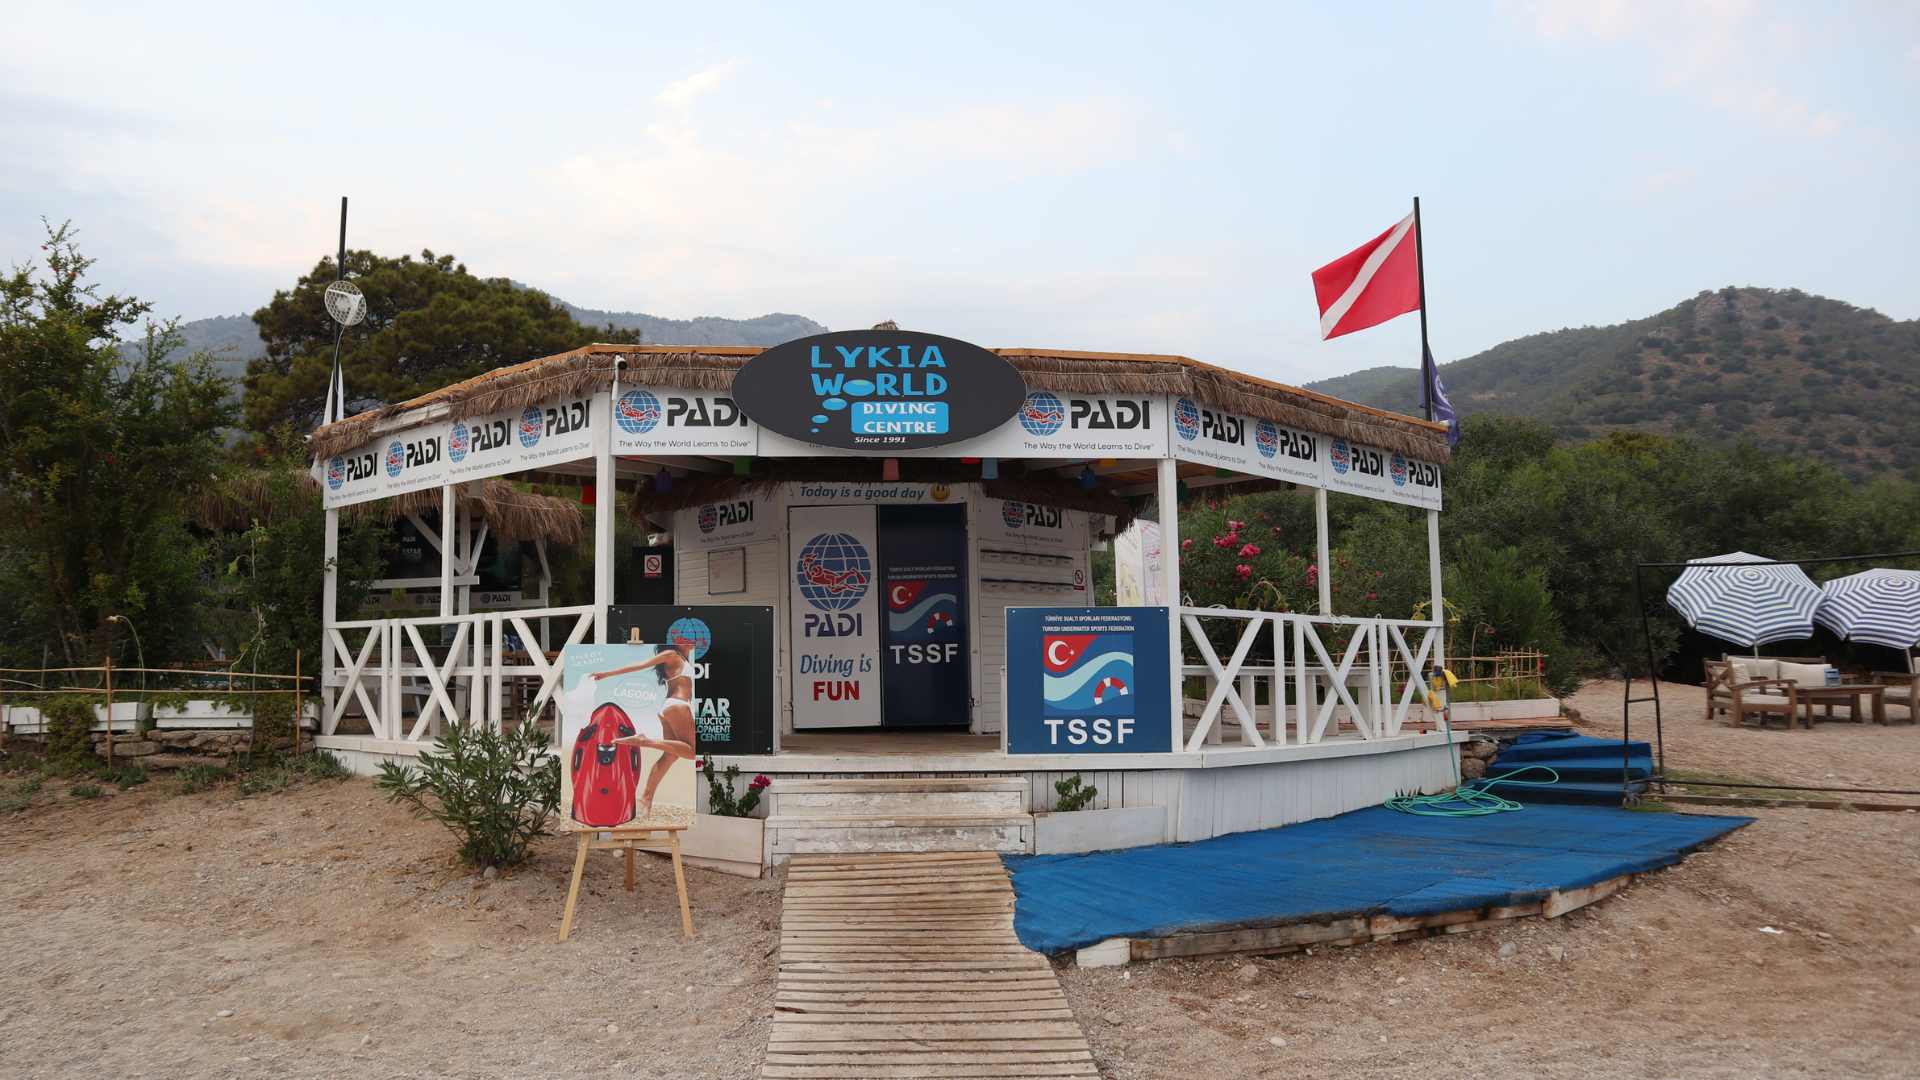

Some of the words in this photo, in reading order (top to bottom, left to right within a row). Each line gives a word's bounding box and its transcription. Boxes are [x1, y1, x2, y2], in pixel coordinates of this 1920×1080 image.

[811, 345, 947, 369] LYKIA
[811, 372, 949, 397] WORLD
[546, 399, 590, 437] PADI
[863, 402, 937, 415] DIVING
[1070, 399, 1151, 430] PADI
[471, 418, 512, 453] PADI
[863, 421, 937, 433] CENTRE
[1202, 409, 1245, 446] PADI
[406, 435, 441, 469] PADI
[634, 440, 652, 450] Way
[654, 440, 667, 448] the
[668, 439, 692, 448] World
[720, 440, 729, 448] to
[854, 436, 880, 444] Since
[883, 436, 907, 444] 1991
[1040, 441, 1057, 451] Way
[1059, 442, 1072, 450] the
[1073, 441, 1096, 450] World
[1280, 428, 1317, 463] PADI
[346, 452, 378, 482] PADI
[1351, 446, 1384, 478] PADI
[1407, 460, 1439, 489] PADI
[799, 485, 838, 500] Today
[840, 486, 851, 497] is
[854, 488, 862, 497] a
[864, 486, 898, 500] good
[901, 486, 925, 501] day
[720, 500, 754, 527] PADI
[1026, 504, 1062, 529] PADI
[804, 612, 863, 638] PADI
[800, 653, 855, 678] Diving
[859, 653, 873, 672] is
[889, 643, 960, 666] TSSF
[614, 687, 657, 699] LAGOON
[813, 680, 861, 701] FUN
[694, 697, 732, 718] TAR
[1044, 717, 1136, 746] TSSF
